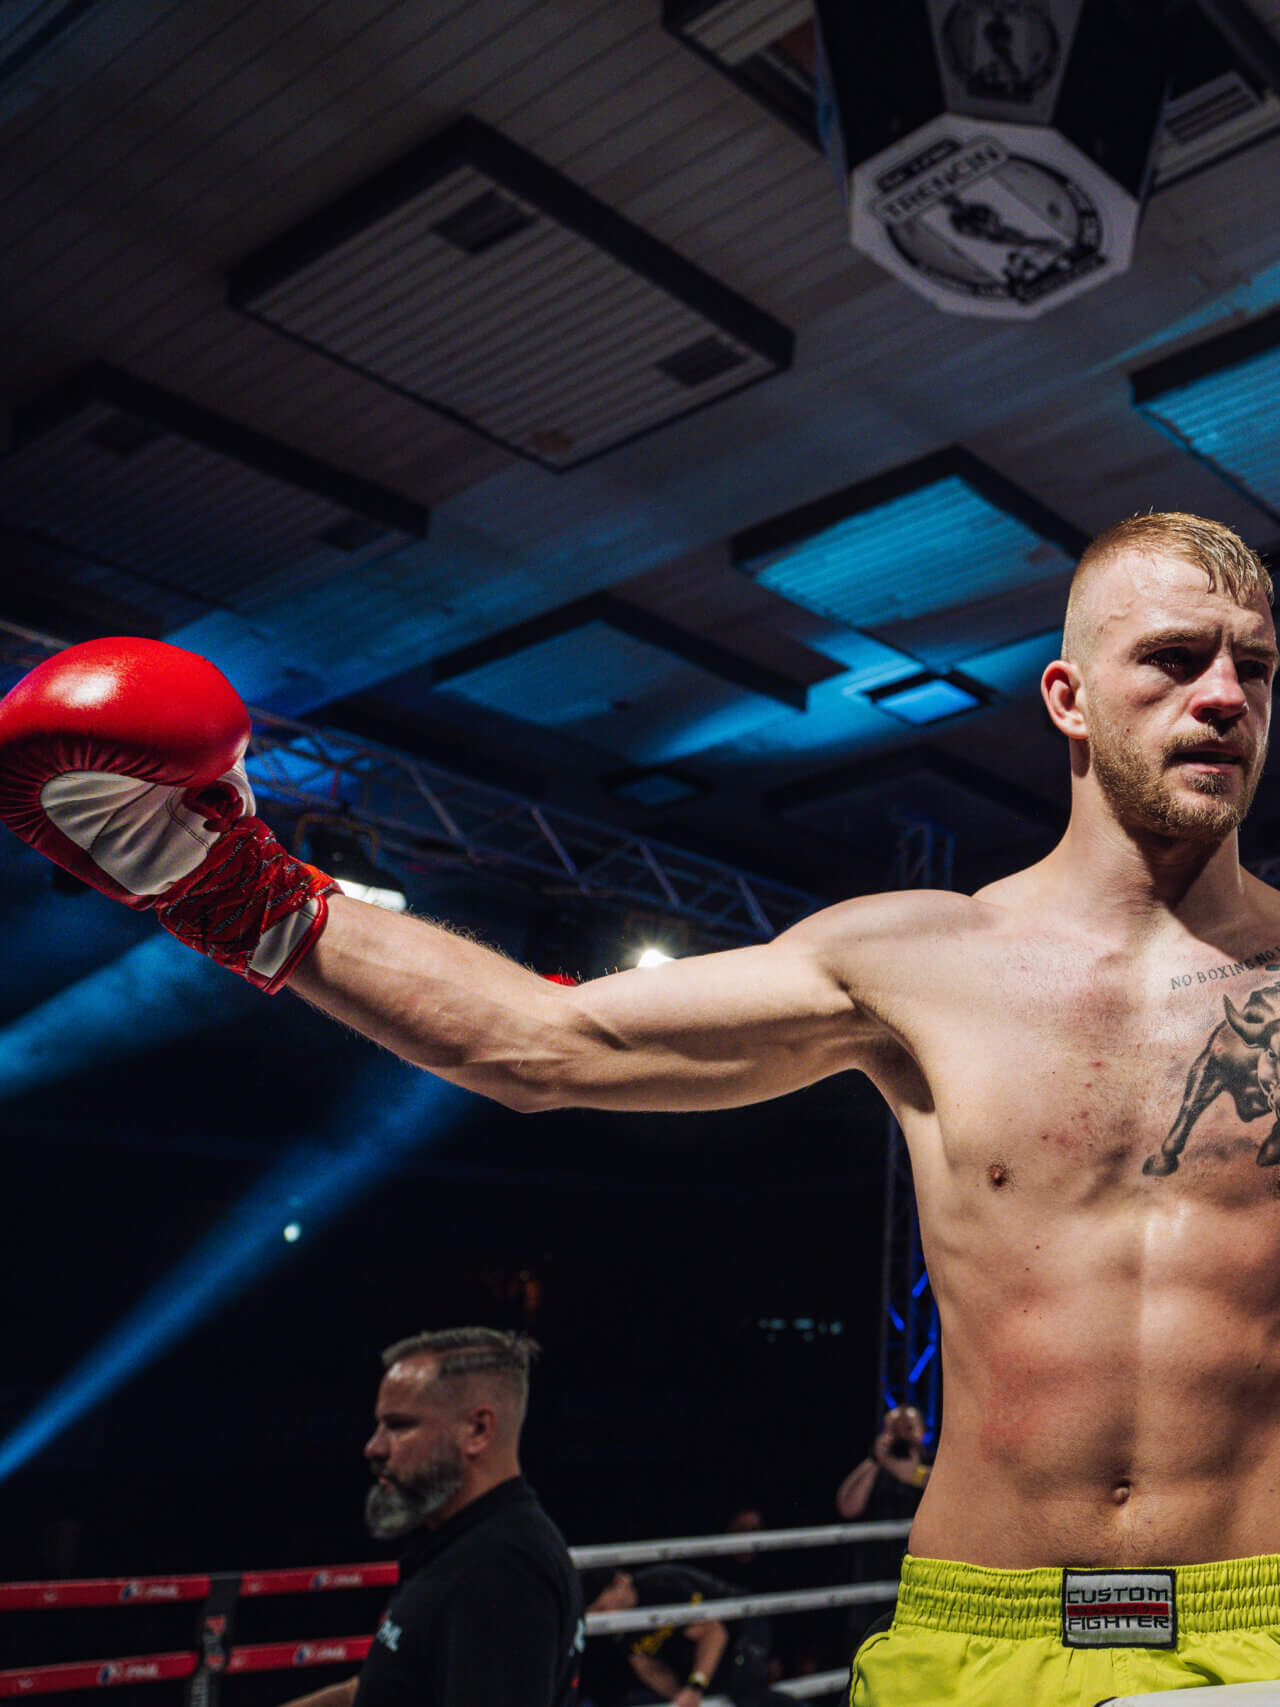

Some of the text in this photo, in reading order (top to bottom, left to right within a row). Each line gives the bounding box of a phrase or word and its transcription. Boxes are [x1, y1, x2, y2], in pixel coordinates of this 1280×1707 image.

[1170, 974, 1192, 990] NO
[1197, 959, 1255, 984] BOXING
[1067, 1587, 1168, 1603] CUSTOM
[1067, 1615, 1169, 1631] FIGHTER
